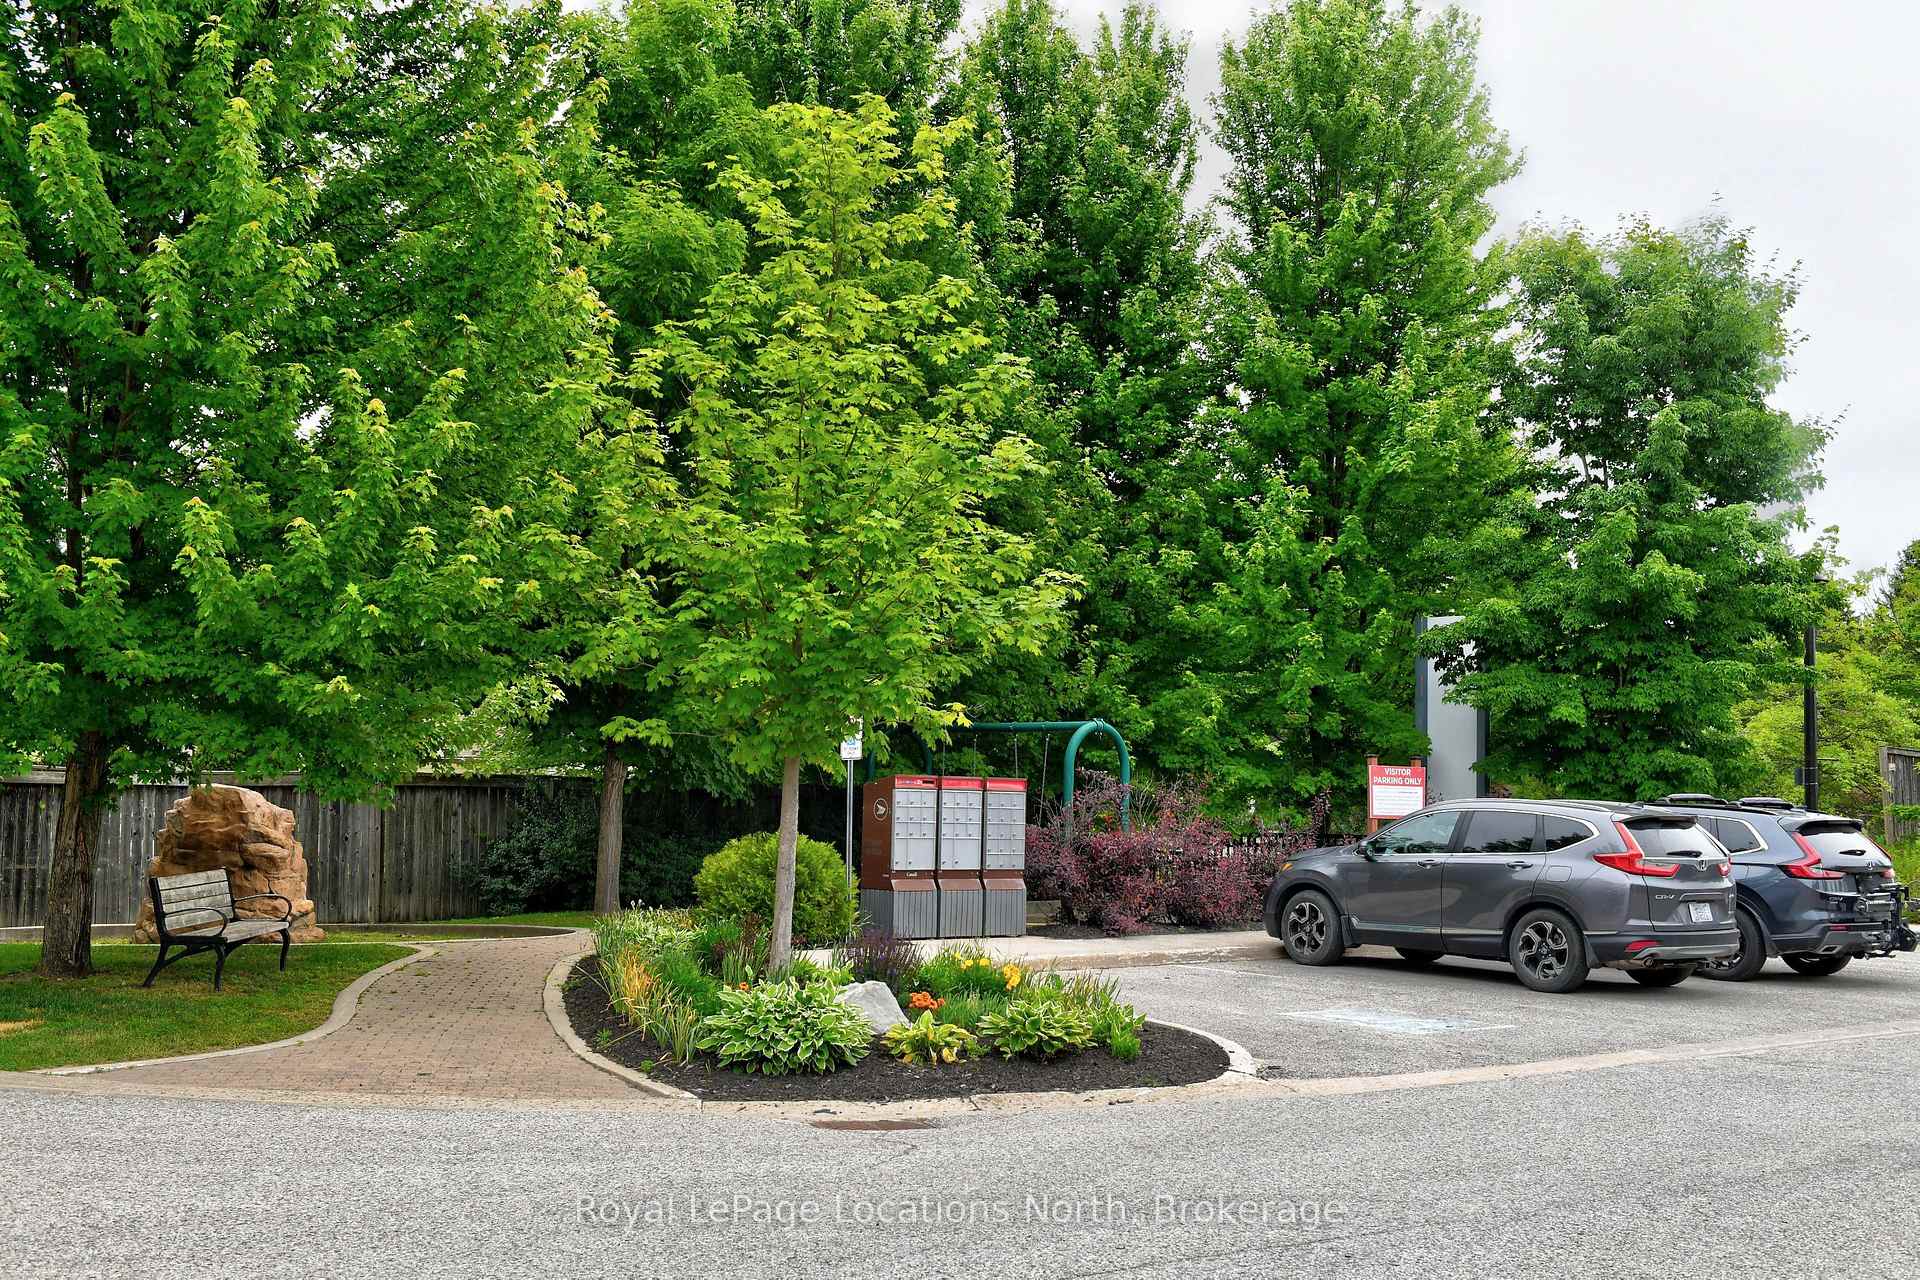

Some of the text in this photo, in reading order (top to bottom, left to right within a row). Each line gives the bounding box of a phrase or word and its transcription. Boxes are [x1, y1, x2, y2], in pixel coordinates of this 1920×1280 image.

[1384, 768, 1411, 776] VISITOR
[1373, 776, 1422, 785] PARKING ONLY
